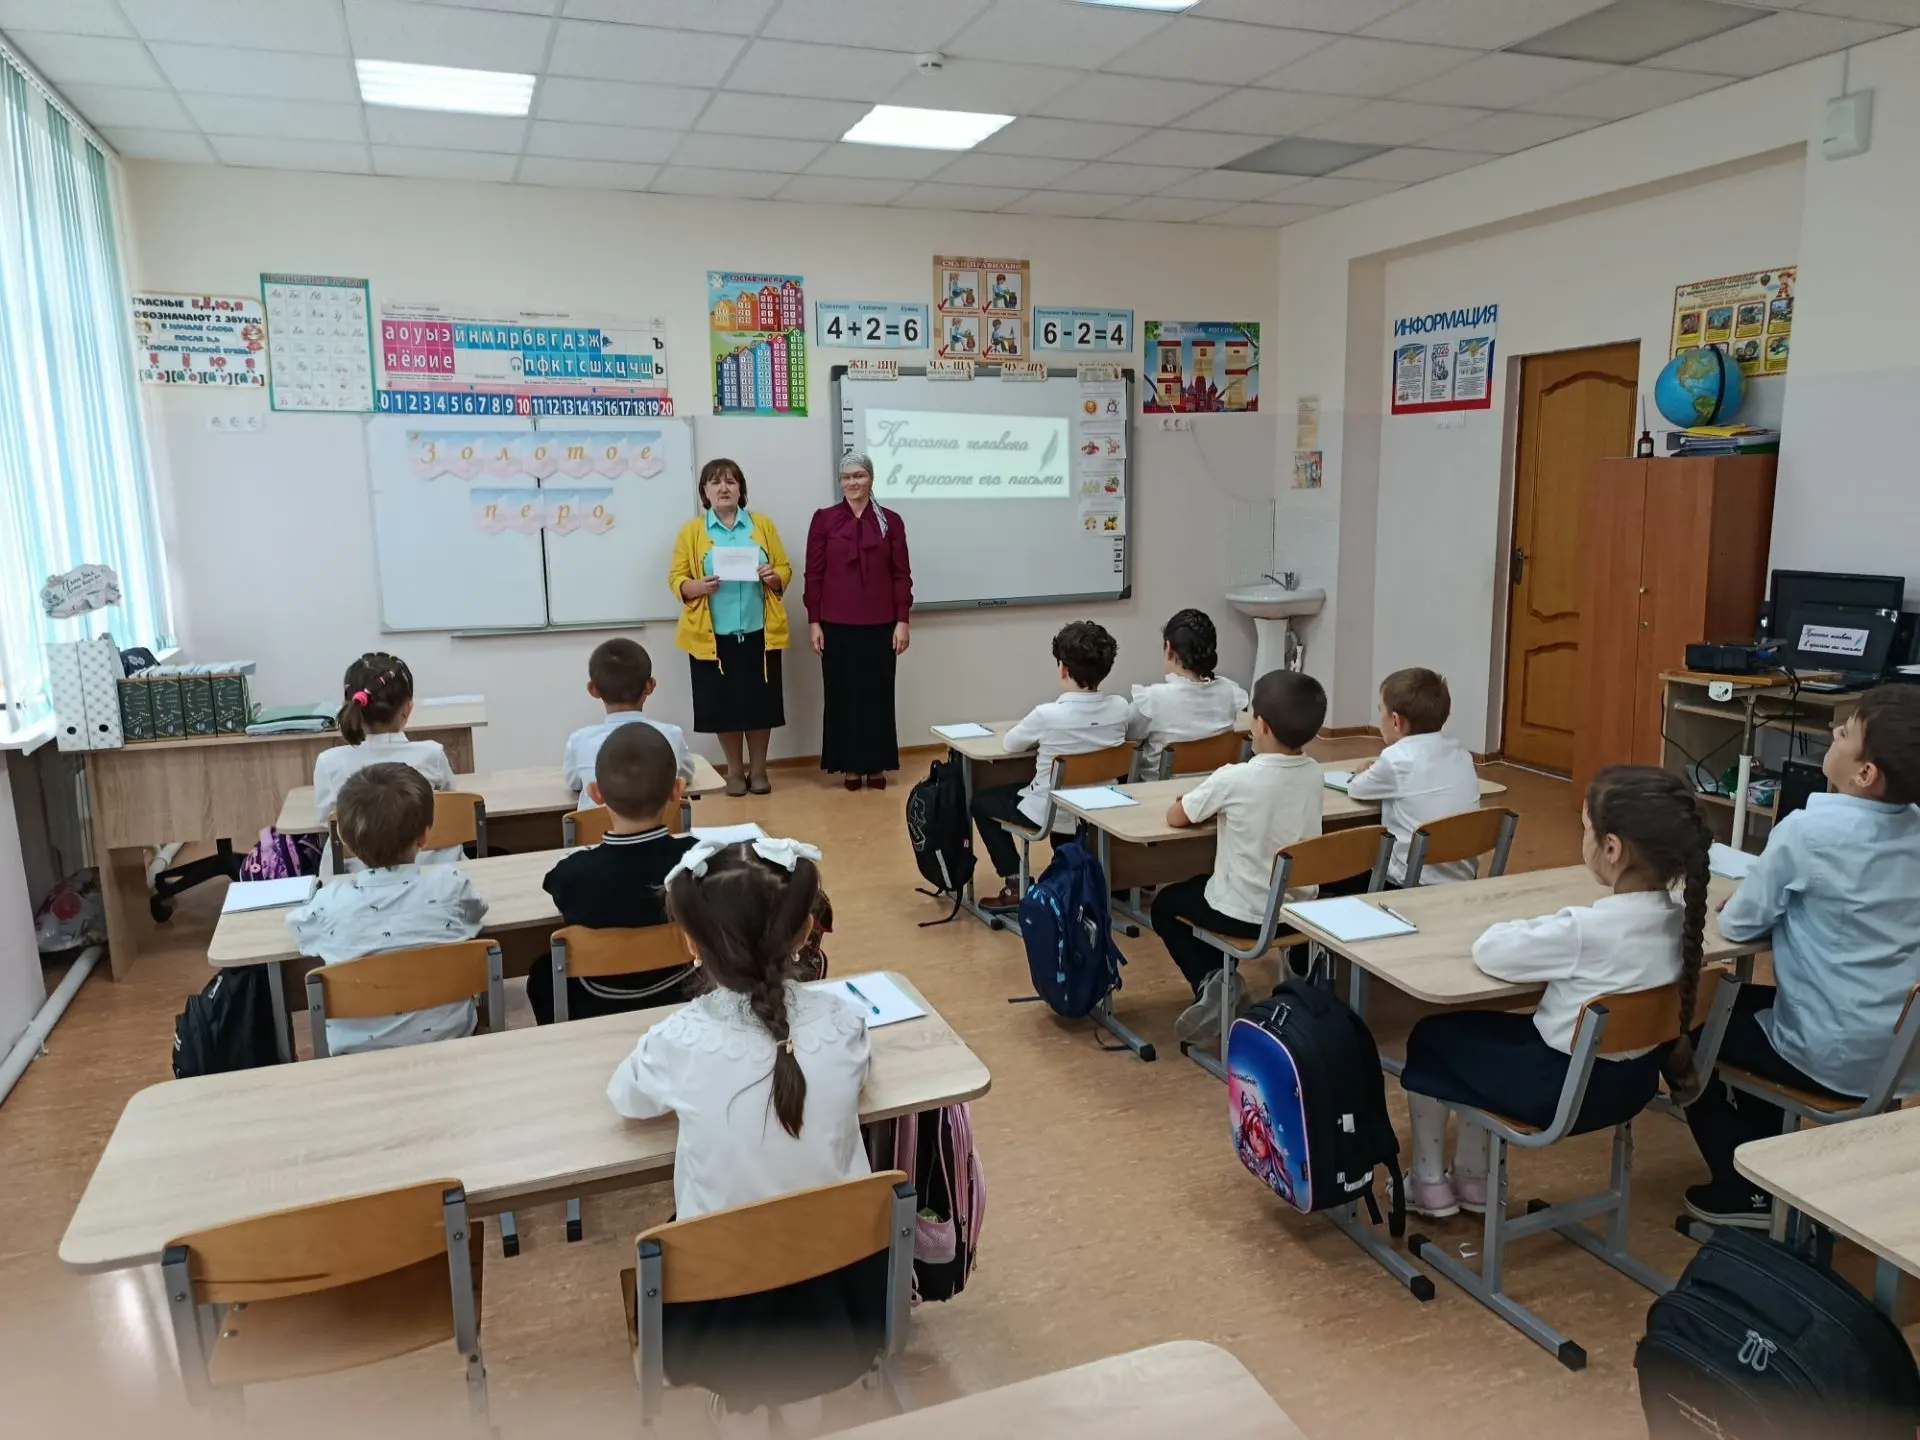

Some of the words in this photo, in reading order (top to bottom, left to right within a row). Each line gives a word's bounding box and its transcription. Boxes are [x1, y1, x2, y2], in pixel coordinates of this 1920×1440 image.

[1394, 303, 1498, 338] ИНФОРМАЦИЯ
[381, 394, 389, 409] 0
[395, 394, 401, 409] 1
[409, 394, 418, 410] 2
[422, 396, 431, 411] 3
[437, 396, 446, 412] 4
[451, 397, 459, 412] 5
[464, 396, 473, 412] 6
[478, 398, 487, 413] 7
[492, 398, 500, 413] 8
[505, 398, 514, 413] 9
[517, 399, 530, 415] 10
[532, 400, 543, 415] 11
[547, 401, 559, 415] 12
[562, 401, 574, 415] 13
[576, 401, 589, 415] 14
[591, 401, 603, 416] 15
[605, 401, 617, 416] 16
[619, 401, 631, 416] 17
[633, 401, 645, 416] 18
[647, 401, 659, 416] 19
[660, 400, 672, 416] 20
[868, 420, 959, 456] Красота
[966, 431, 1028, 451] человека
[421, 442, 650, 463] Золотое
[887, 464, 902, 485] в
[906, 474, 973, 493] красоте
[979, 475, 1002, 485] его
[1008, 474, 1064, 485] письма
[485, 503, 604, 525] перо
